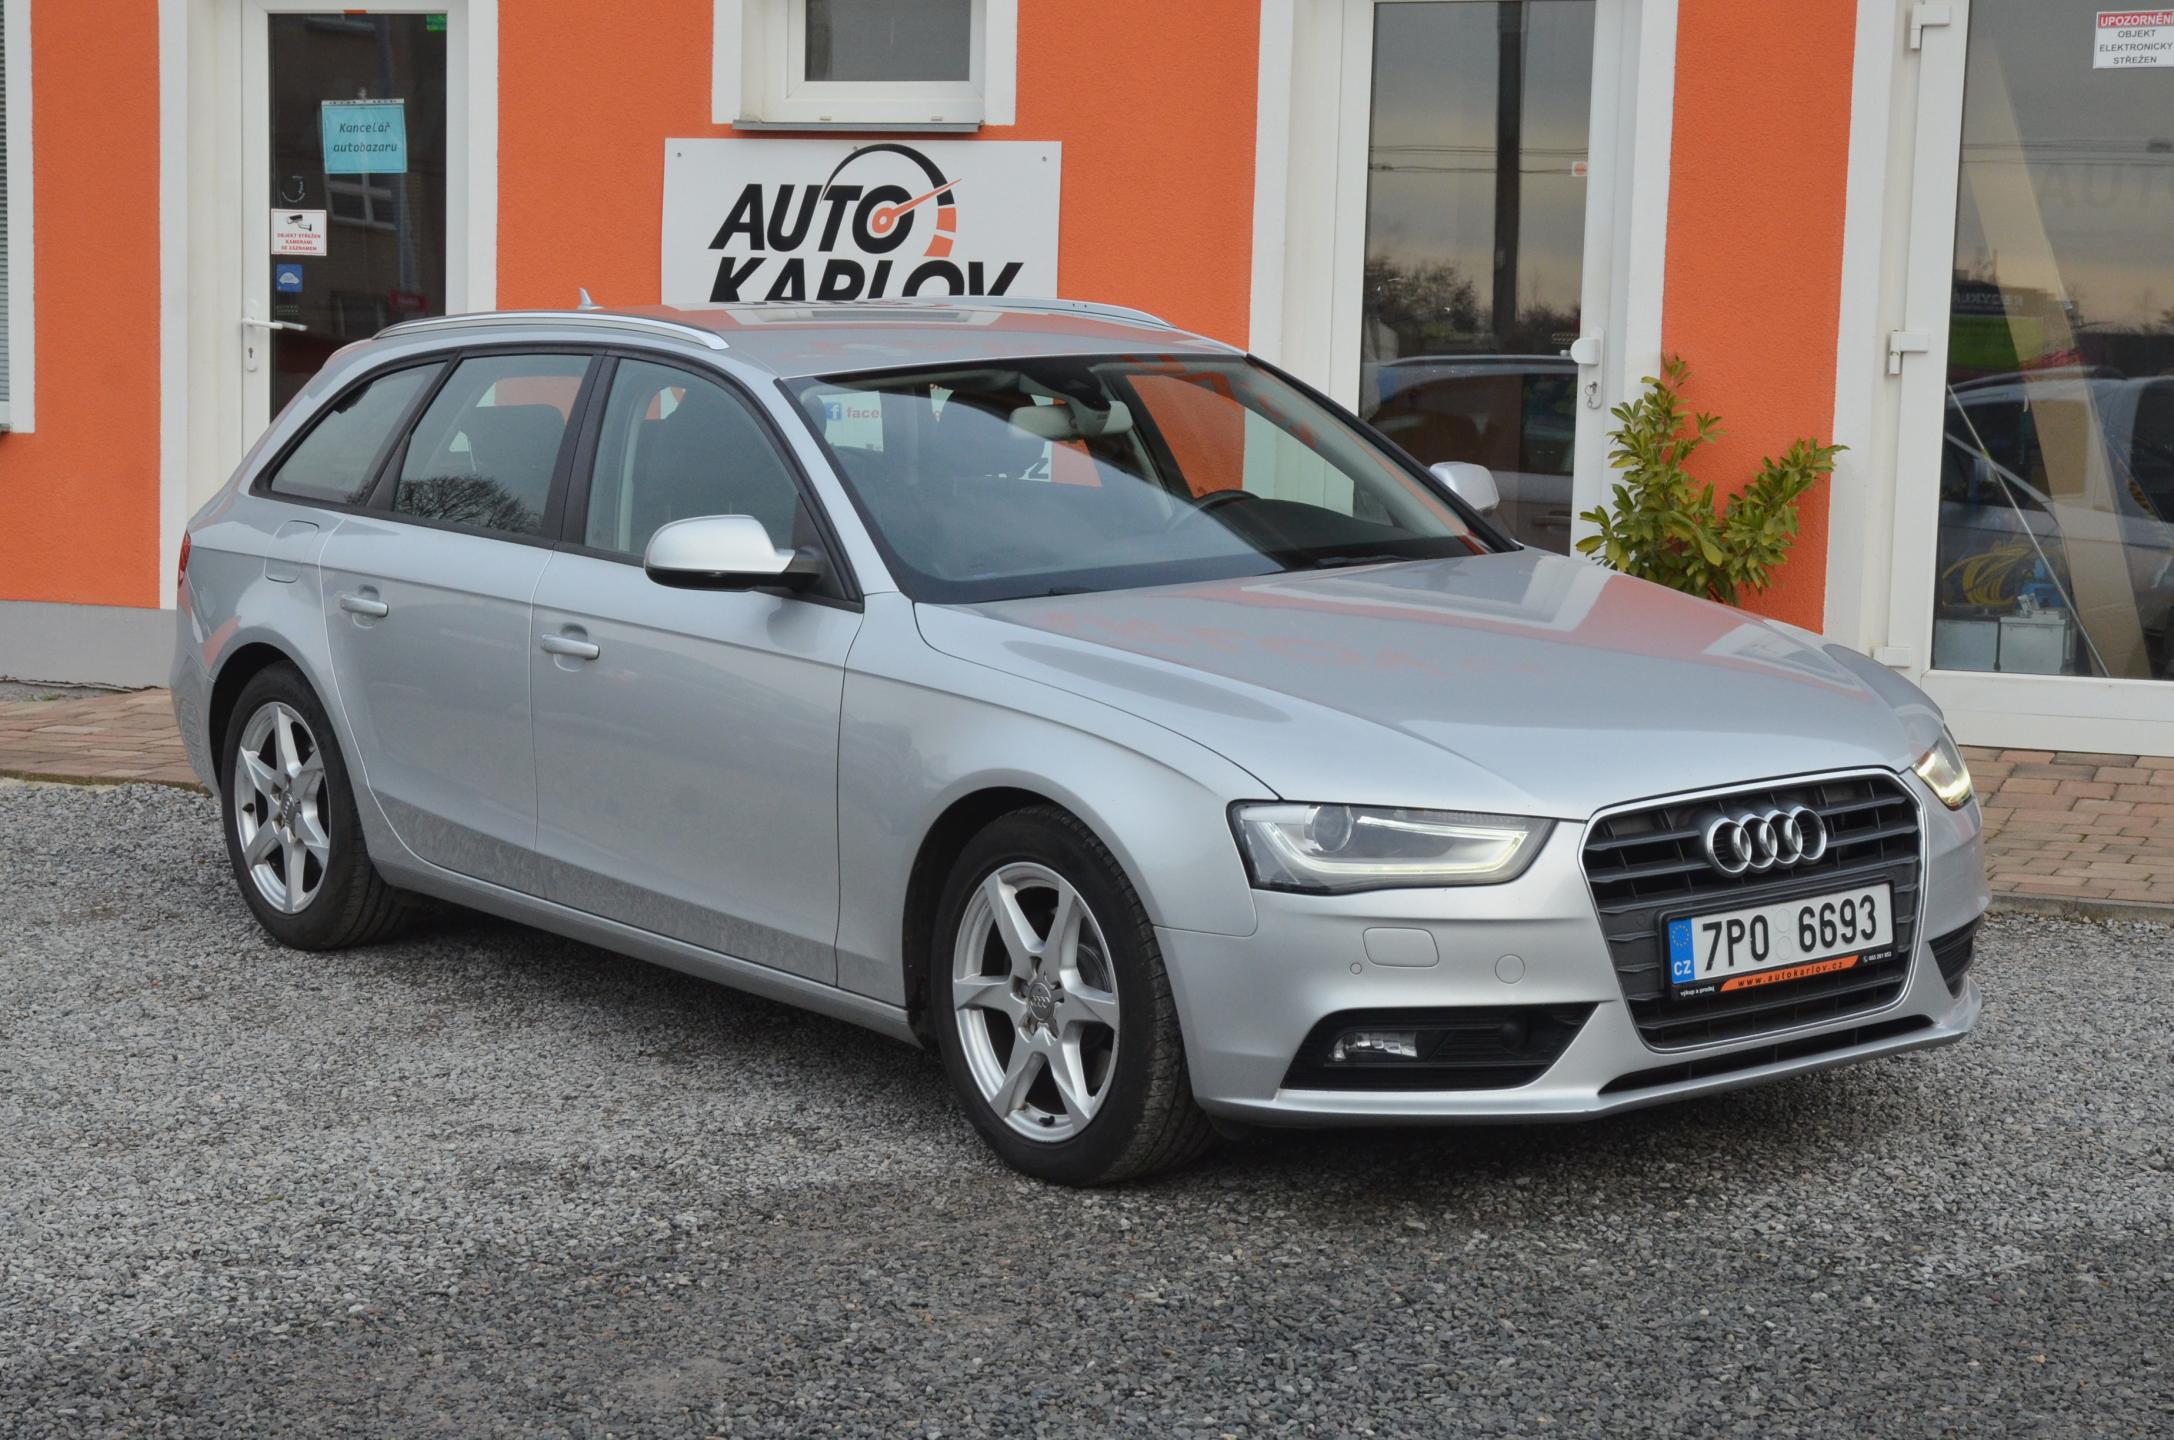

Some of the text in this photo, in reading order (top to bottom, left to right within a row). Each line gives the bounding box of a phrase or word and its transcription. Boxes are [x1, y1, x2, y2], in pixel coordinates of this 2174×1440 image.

[2118, 29, 2156, 38] OBJEKT
[2099, 42, 2173, 52] ELEKTRONICKY
[2113, 54, 2157, 65] STŘEŽEN
[333, 143, 398, 153] autobazaru
[707, 182, 916, 255] AUTO
[1798, 894, 1877, 953] 6693
[1673, 959, 1692, 976] CZ
[1737, 961, 1843, 987] www.autokarlov.cz
